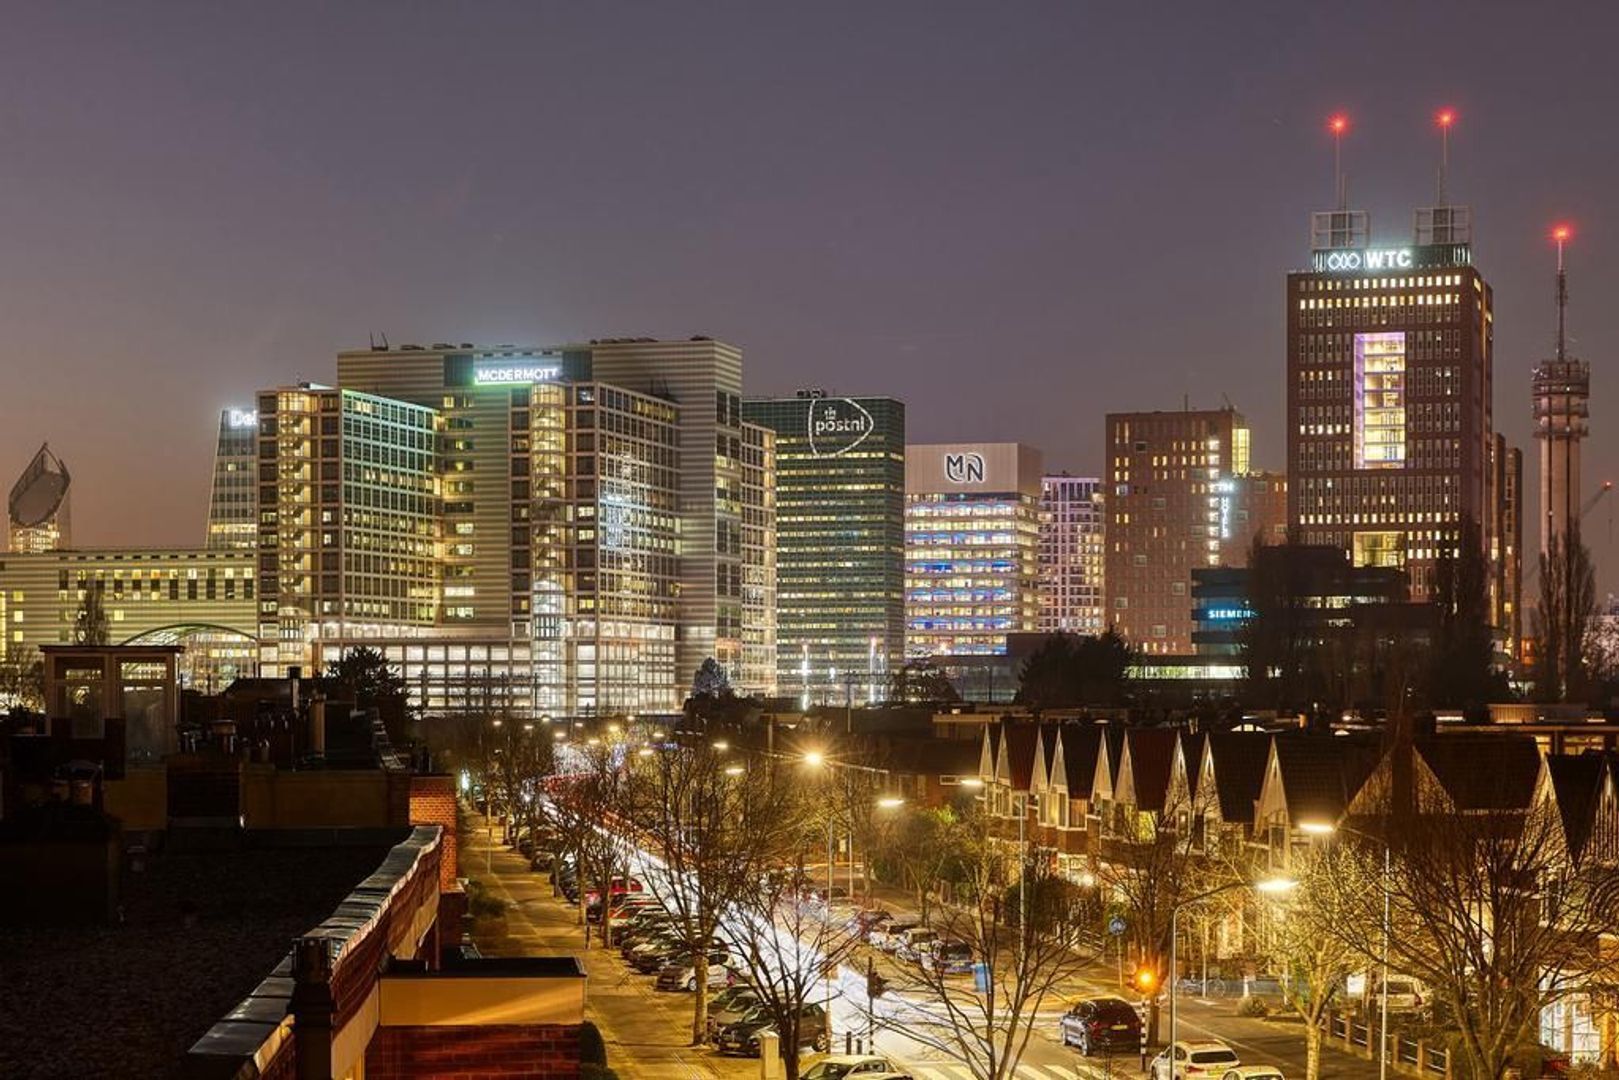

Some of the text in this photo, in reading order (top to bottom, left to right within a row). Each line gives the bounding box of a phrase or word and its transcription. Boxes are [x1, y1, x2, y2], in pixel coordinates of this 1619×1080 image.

[1366, 250, 1411, 268] WTC
[478, 367, 558, 381] MCDERMOTT
[815, 415, 865, 436] postnl
[945, 453, 986, 482] MN
[1208, 609, 1257, 619] SIEMEN
